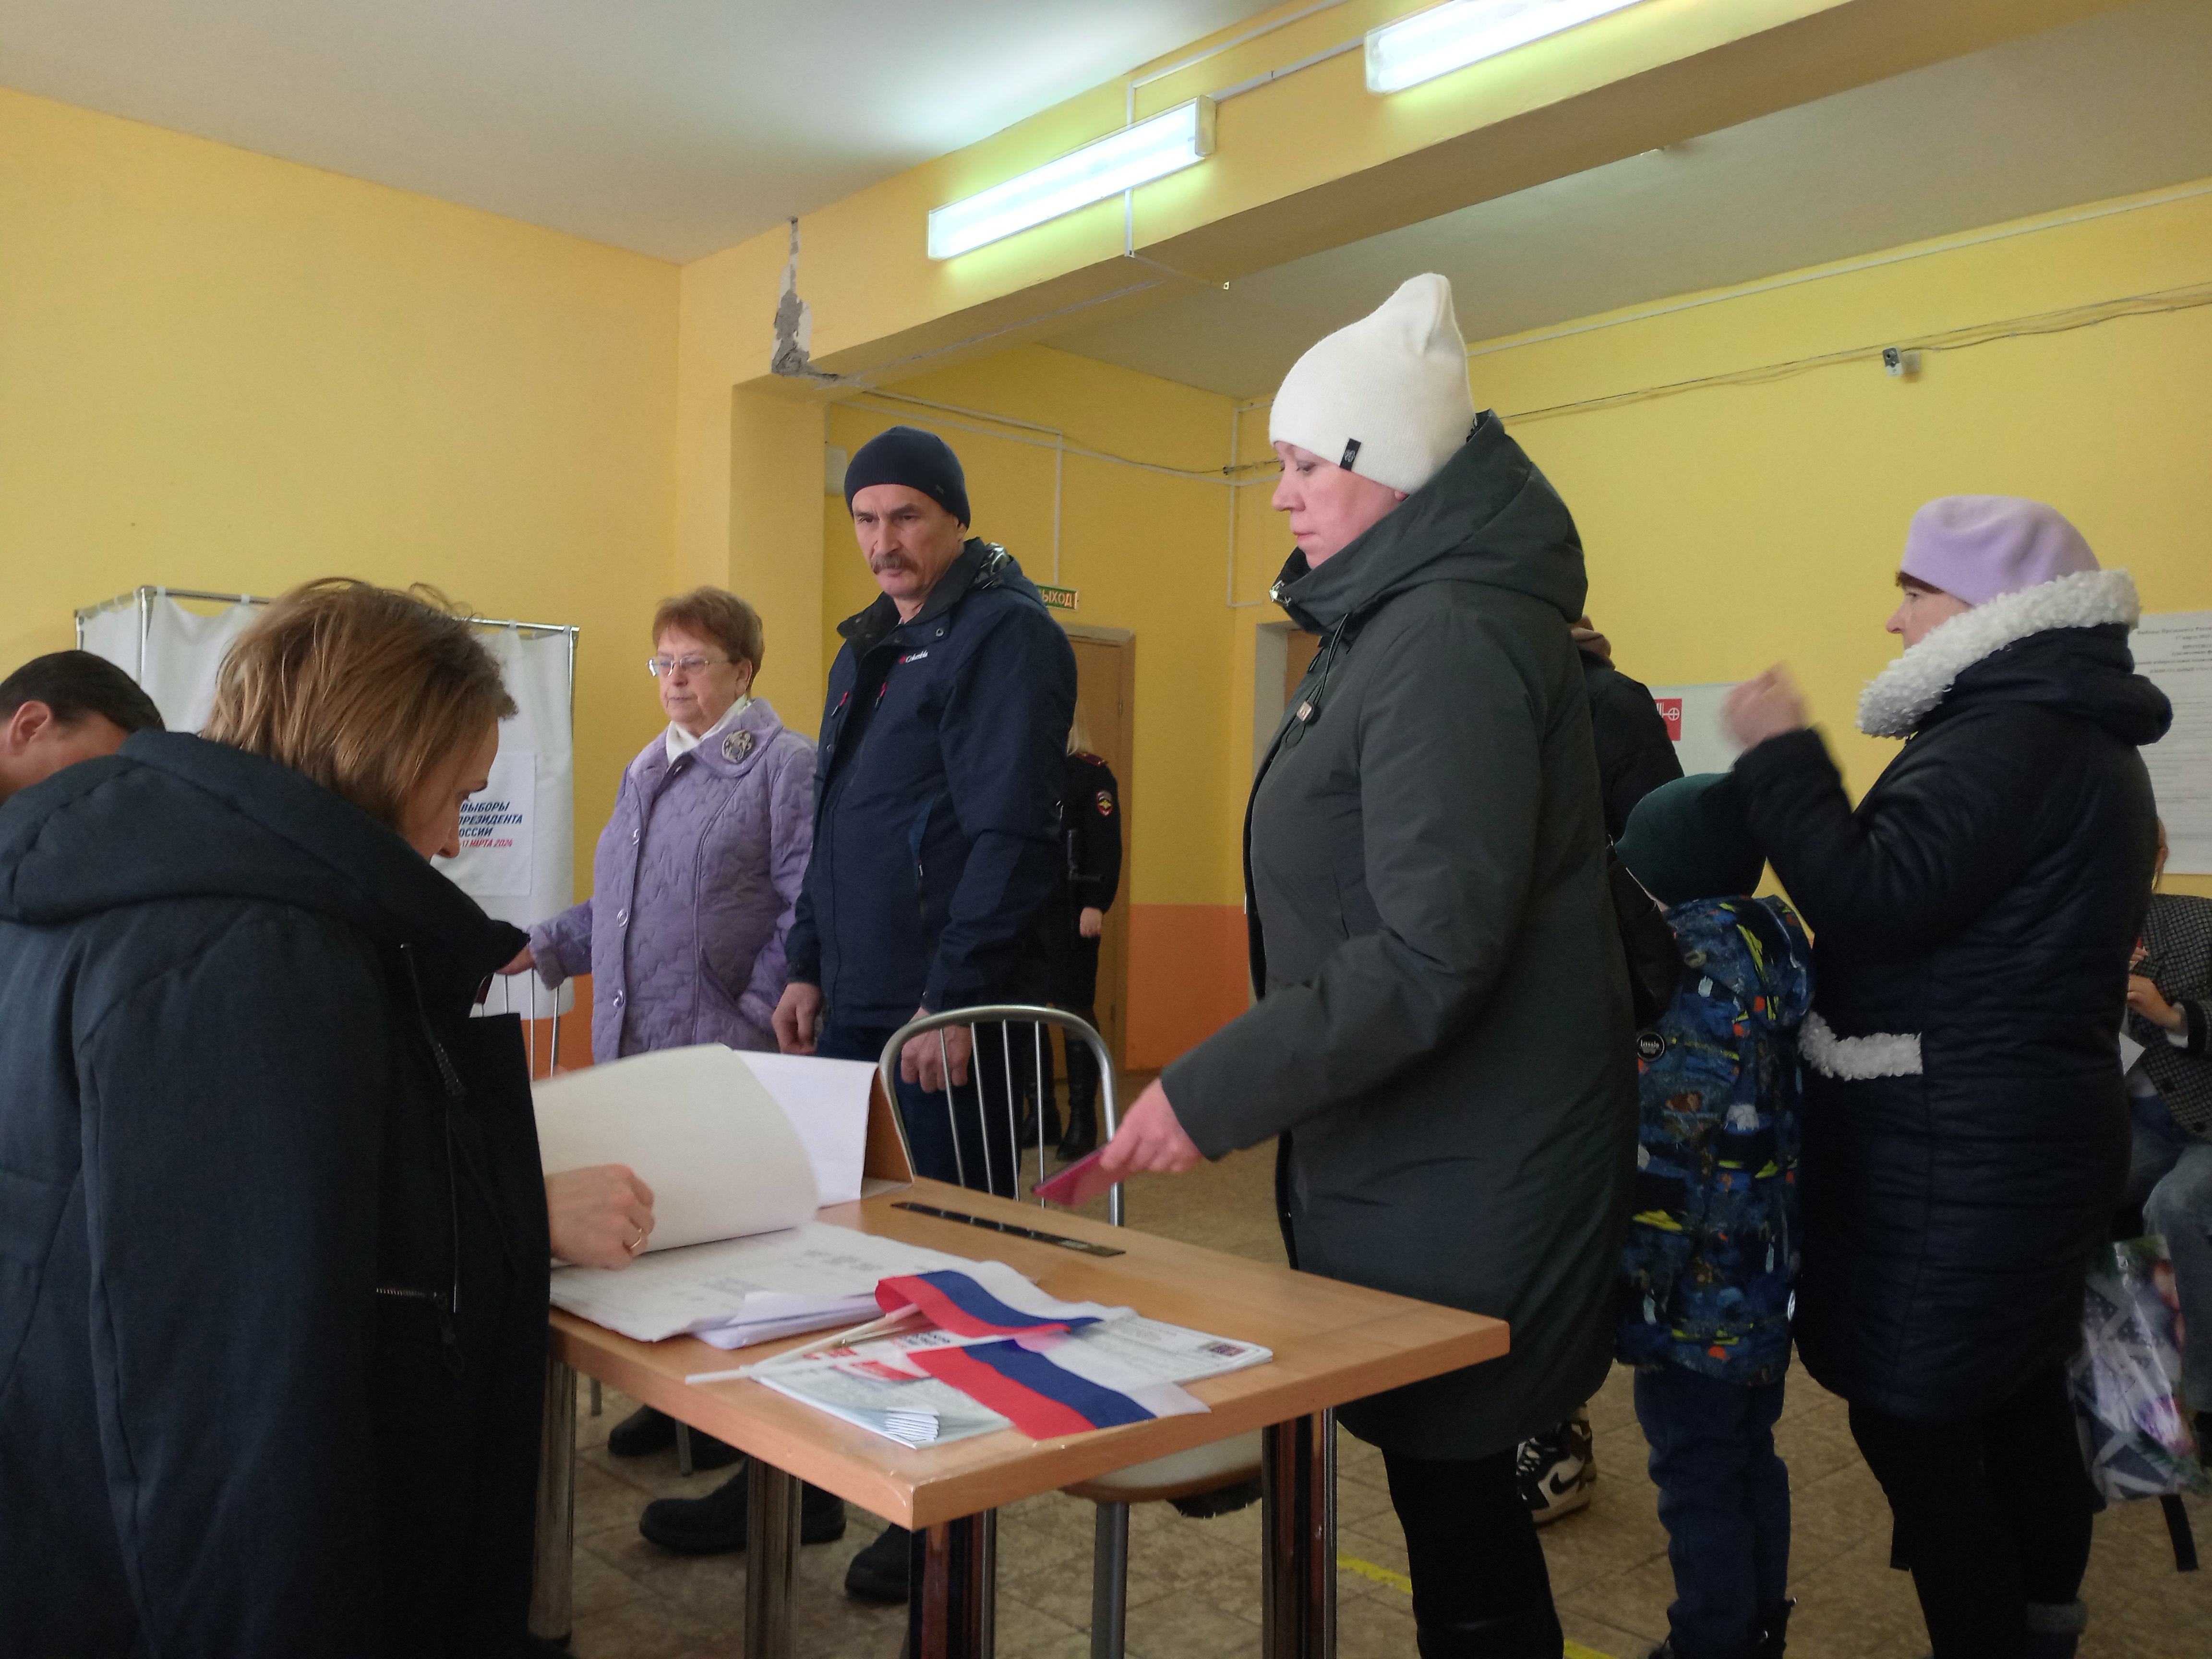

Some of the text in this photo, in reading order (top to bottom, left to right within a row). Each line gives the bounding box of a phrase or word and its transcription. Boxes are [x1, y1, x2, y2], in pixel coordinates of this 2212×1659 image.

[1040, 589, 1072, 607] ЫХОД
[460, 801, 510, 813] ВЫБОРЫ
[459, 827, 493, 837] ОССИИ
[469, 839, 493, 847] МАРТА
